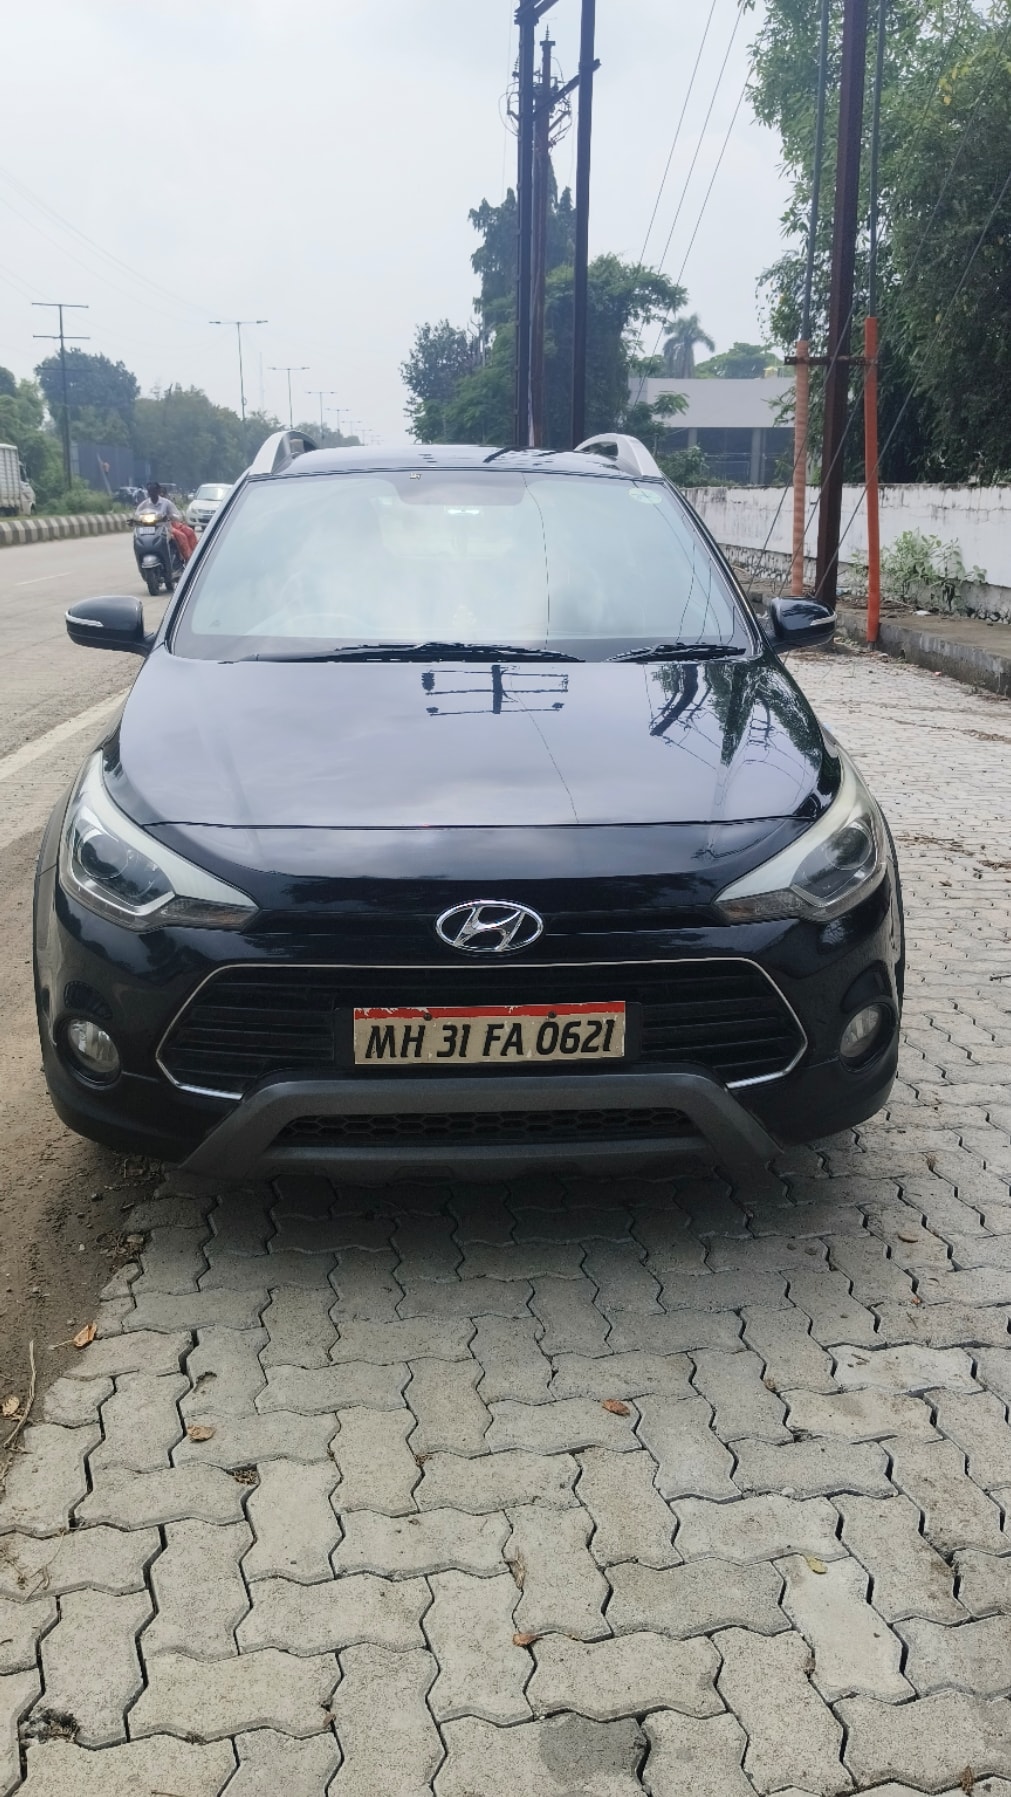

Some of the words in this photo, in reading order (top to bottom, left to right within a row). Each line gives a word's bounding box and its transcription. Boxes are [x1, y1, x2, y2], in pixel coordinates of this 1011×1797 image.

[365, 1025, 426, 1058] MH
[436, 1024, 471, 1057] 31
[482, 1022, 524, 1057] FA
[536, 1018, 616, 1055] 0621
